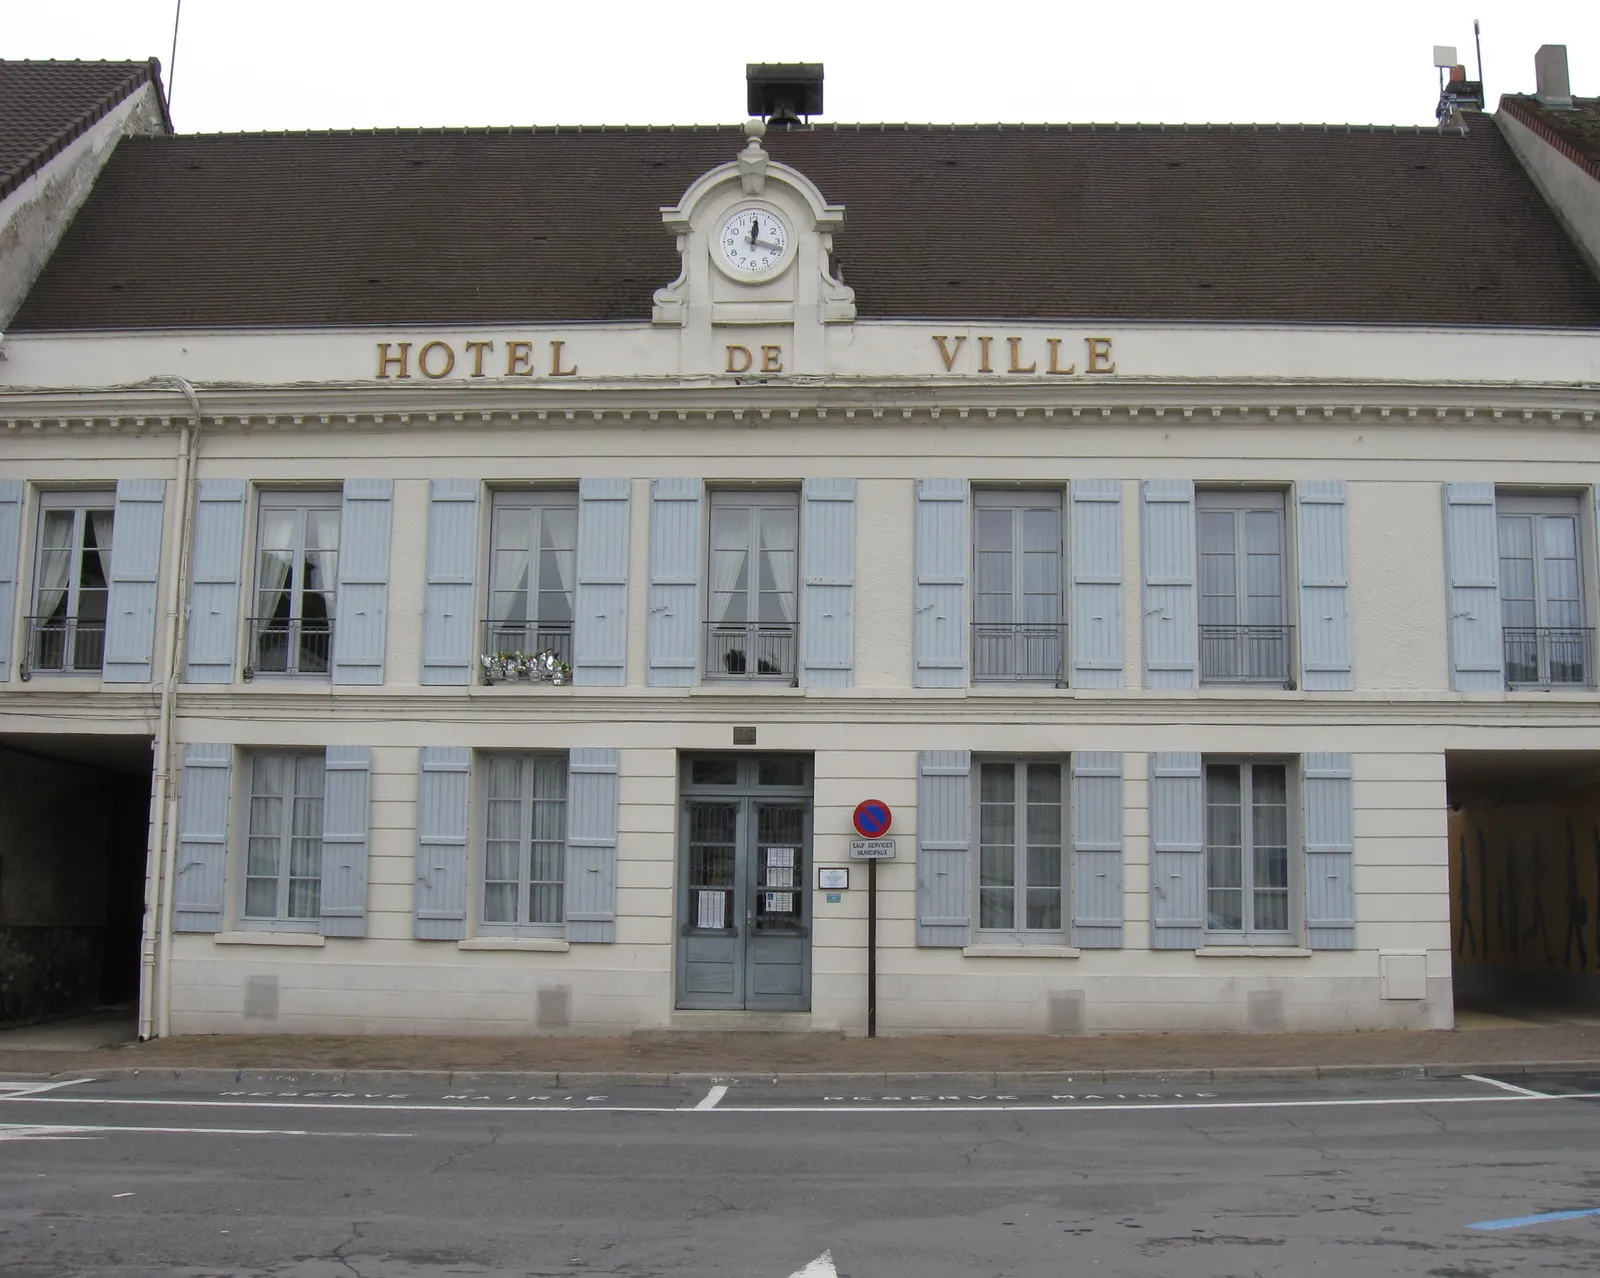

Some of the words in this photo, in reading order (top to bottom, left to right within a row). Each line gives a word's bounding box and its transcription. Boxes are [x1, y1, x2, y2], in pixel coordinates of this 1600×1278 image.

[375, 340, 578, 379] HOTEL
[724, 344, 783, 373] DE
[931, 335, 1116, 375] VILLE
